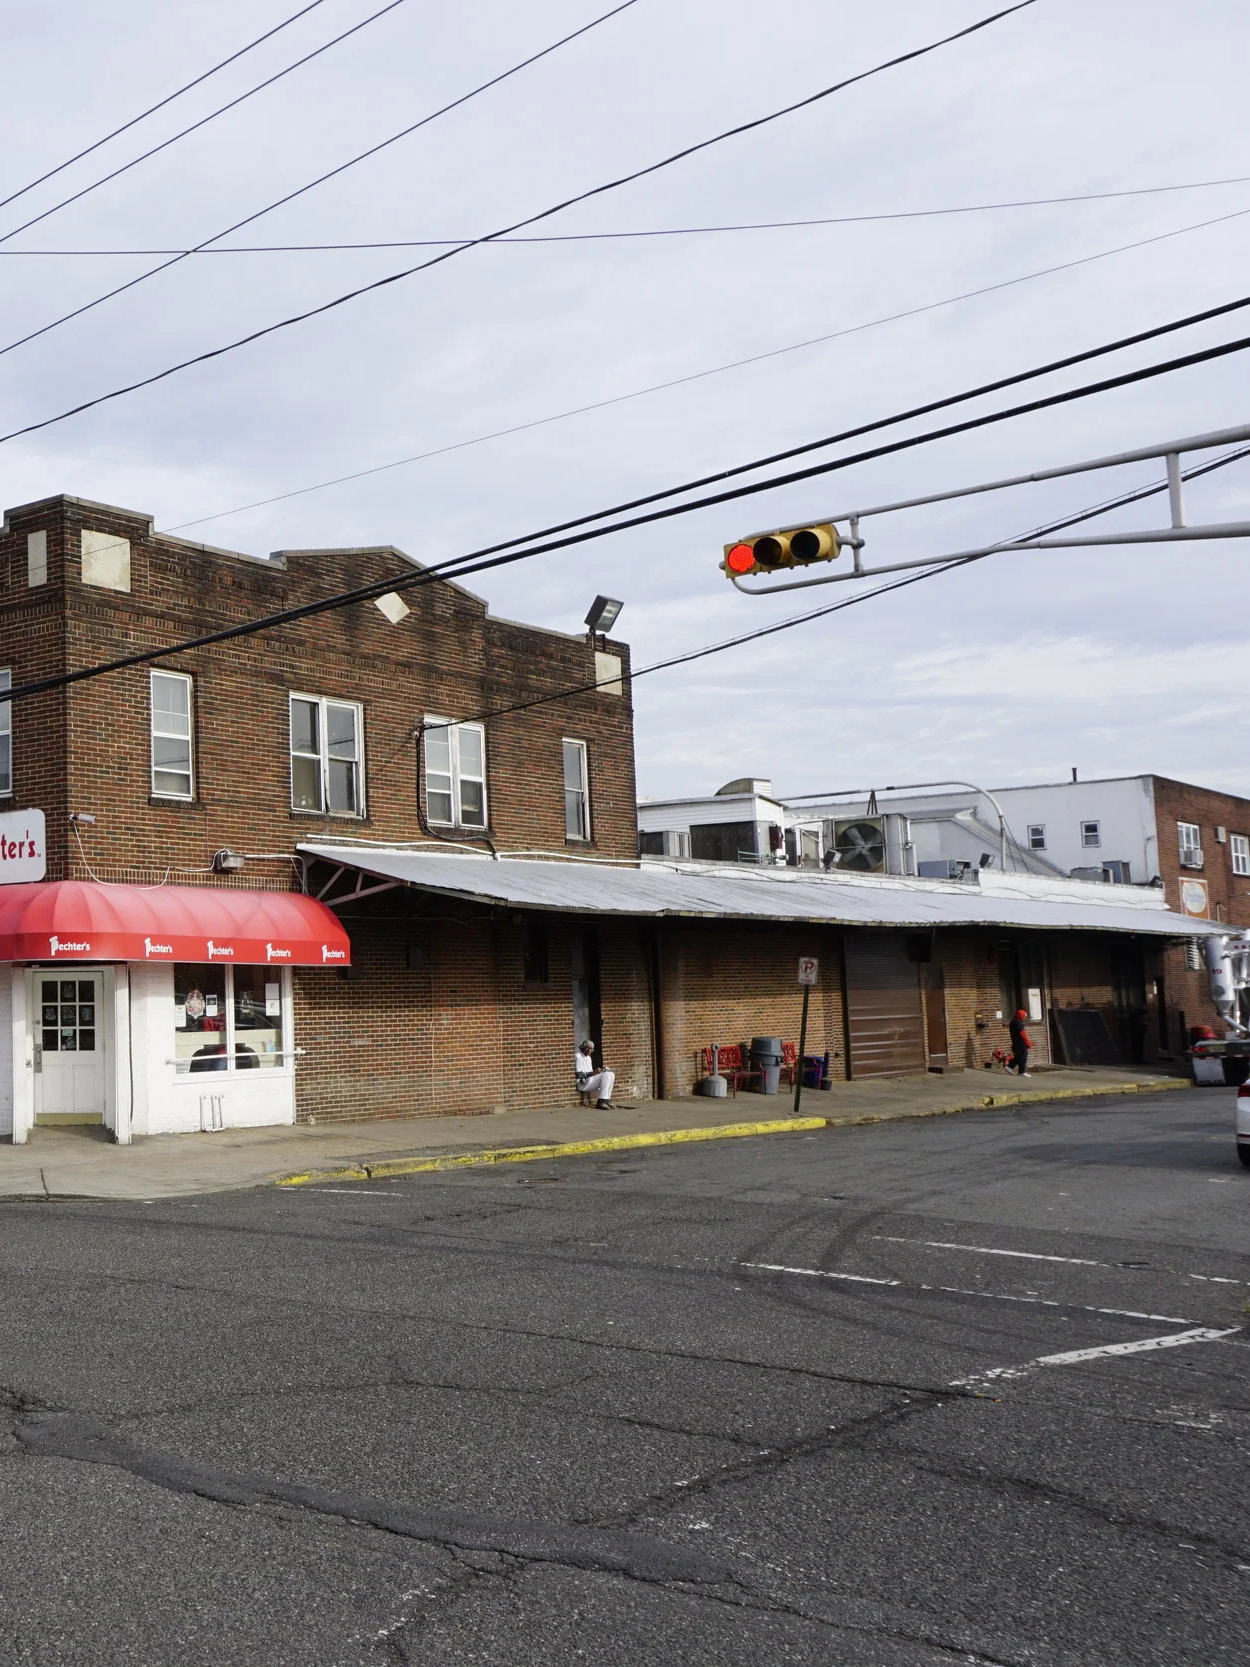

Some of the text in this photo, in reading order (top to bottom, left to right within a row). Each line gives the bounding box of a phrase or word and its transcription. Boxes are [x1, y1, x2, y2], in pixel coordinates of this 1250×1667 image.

[49, 936, 91, 956] Pechter's
[144, 937, 173, 957] Pechter's
[207, 940, 234, 959] Pechter's
[266, 942, 291, 961] Pechter's
[322, 944, 345, 962] Pechter's
